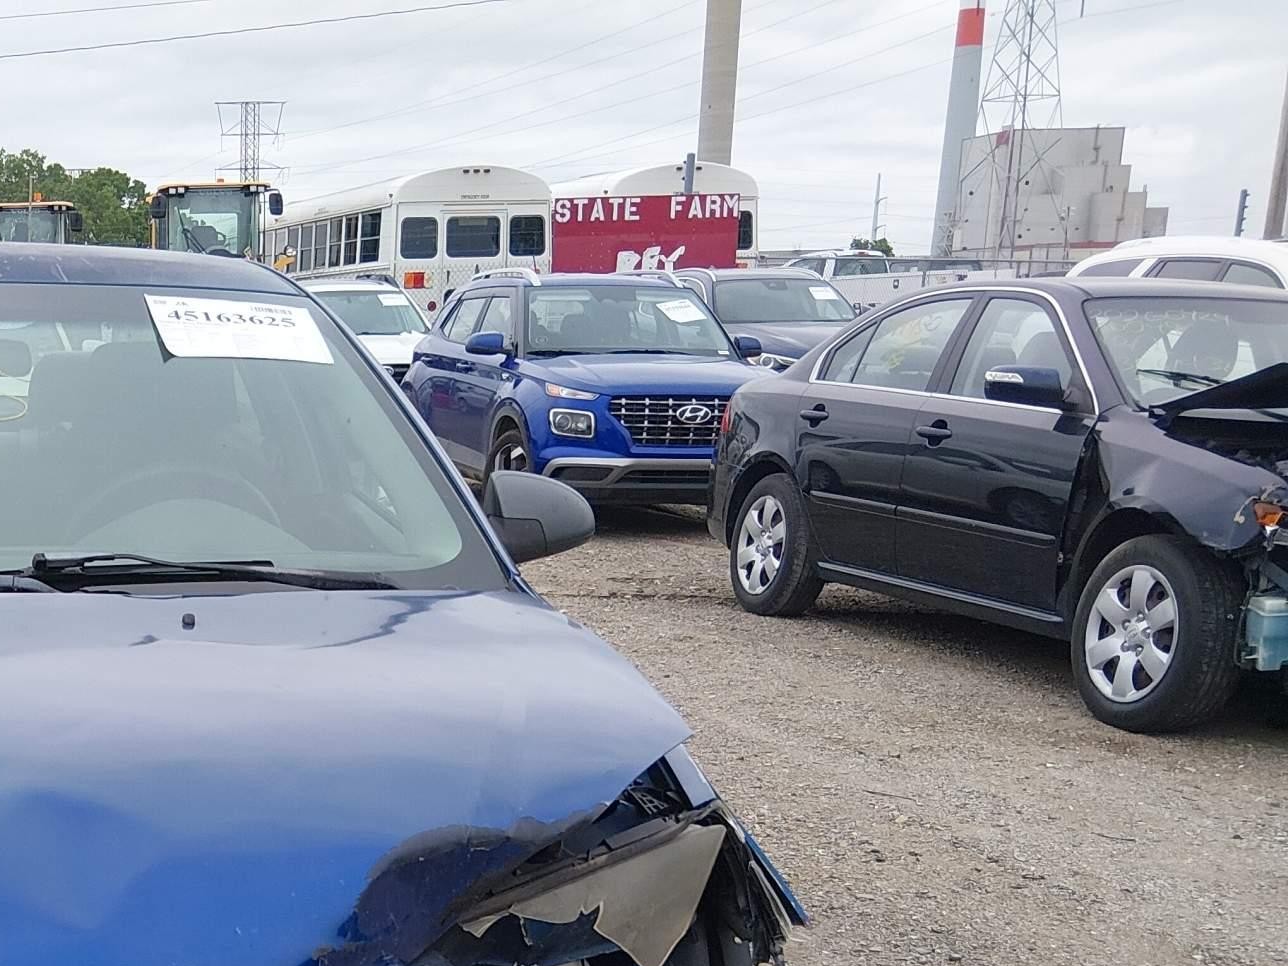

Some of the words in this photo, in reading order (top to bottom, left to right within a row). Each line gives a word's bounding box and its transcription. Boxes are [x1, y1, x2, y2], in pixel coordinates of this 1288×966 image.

[556, 198, 640, 223] STATE
[670, 195, 741, 219] FARM
[167, 310, 296, 327] 45163625
